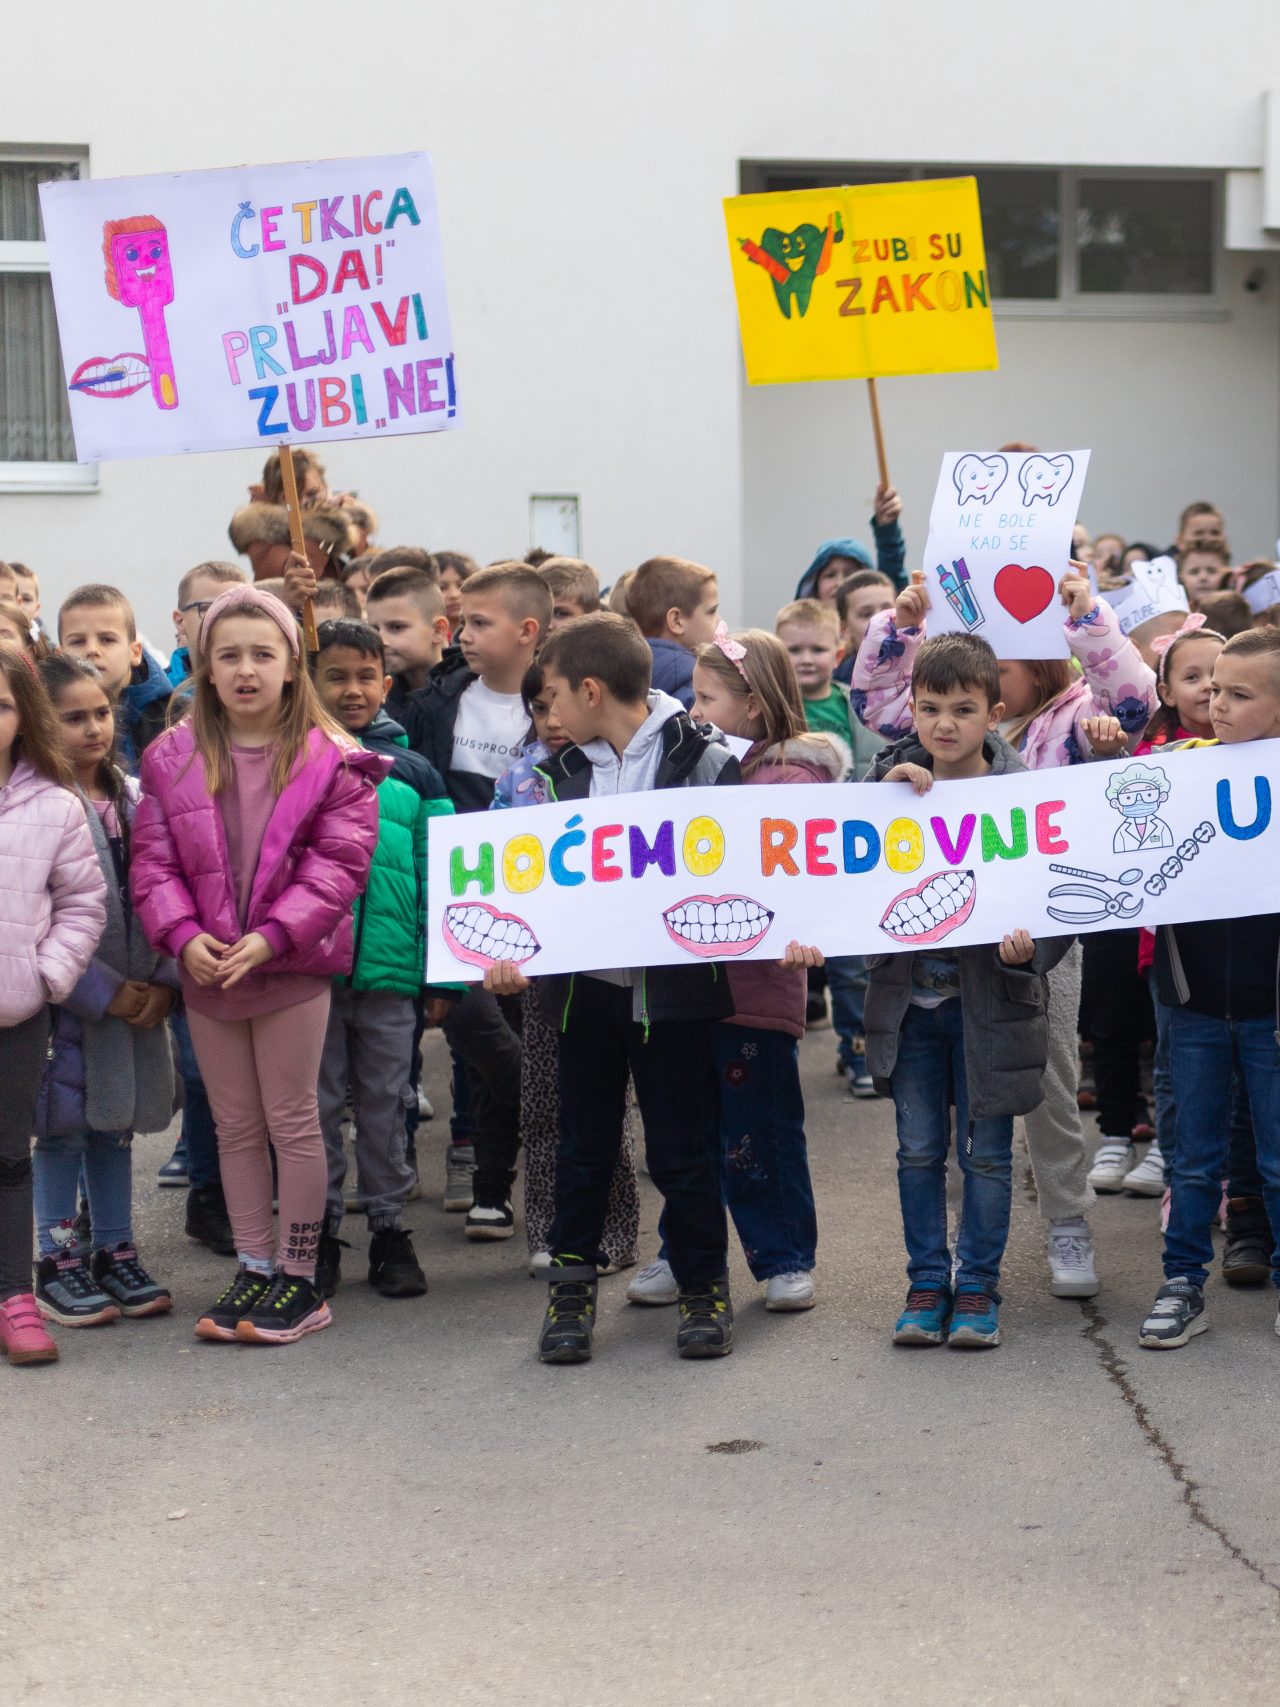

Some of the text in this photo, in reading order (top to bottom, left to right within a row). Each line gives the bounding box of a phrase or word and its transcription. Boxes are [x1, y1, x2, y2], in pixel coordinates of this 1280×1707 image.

[230, 187, 421, 258] ČETKICA
[852, 233, 961, 264] ZUBI SU
[835, 269, 988, 317] ZAKON
[222, 292, 428, 385] PRLJAVI
[248, 373, 368, 436] ZUBI
[959, 513, 1037, 528] NE BOLE
[970, 535, 1029, 551] KAD SE
[448, 813, 725, 897] HOĆEMO
[760, 799, 1070, 877] REDOVNE
[1216, 775, 1272, 841] U
[289, 1234, 318, 1247] SPO
[291, 1221, 320, 1234] SPO
[287, 1248, 317, 1260] SPO
